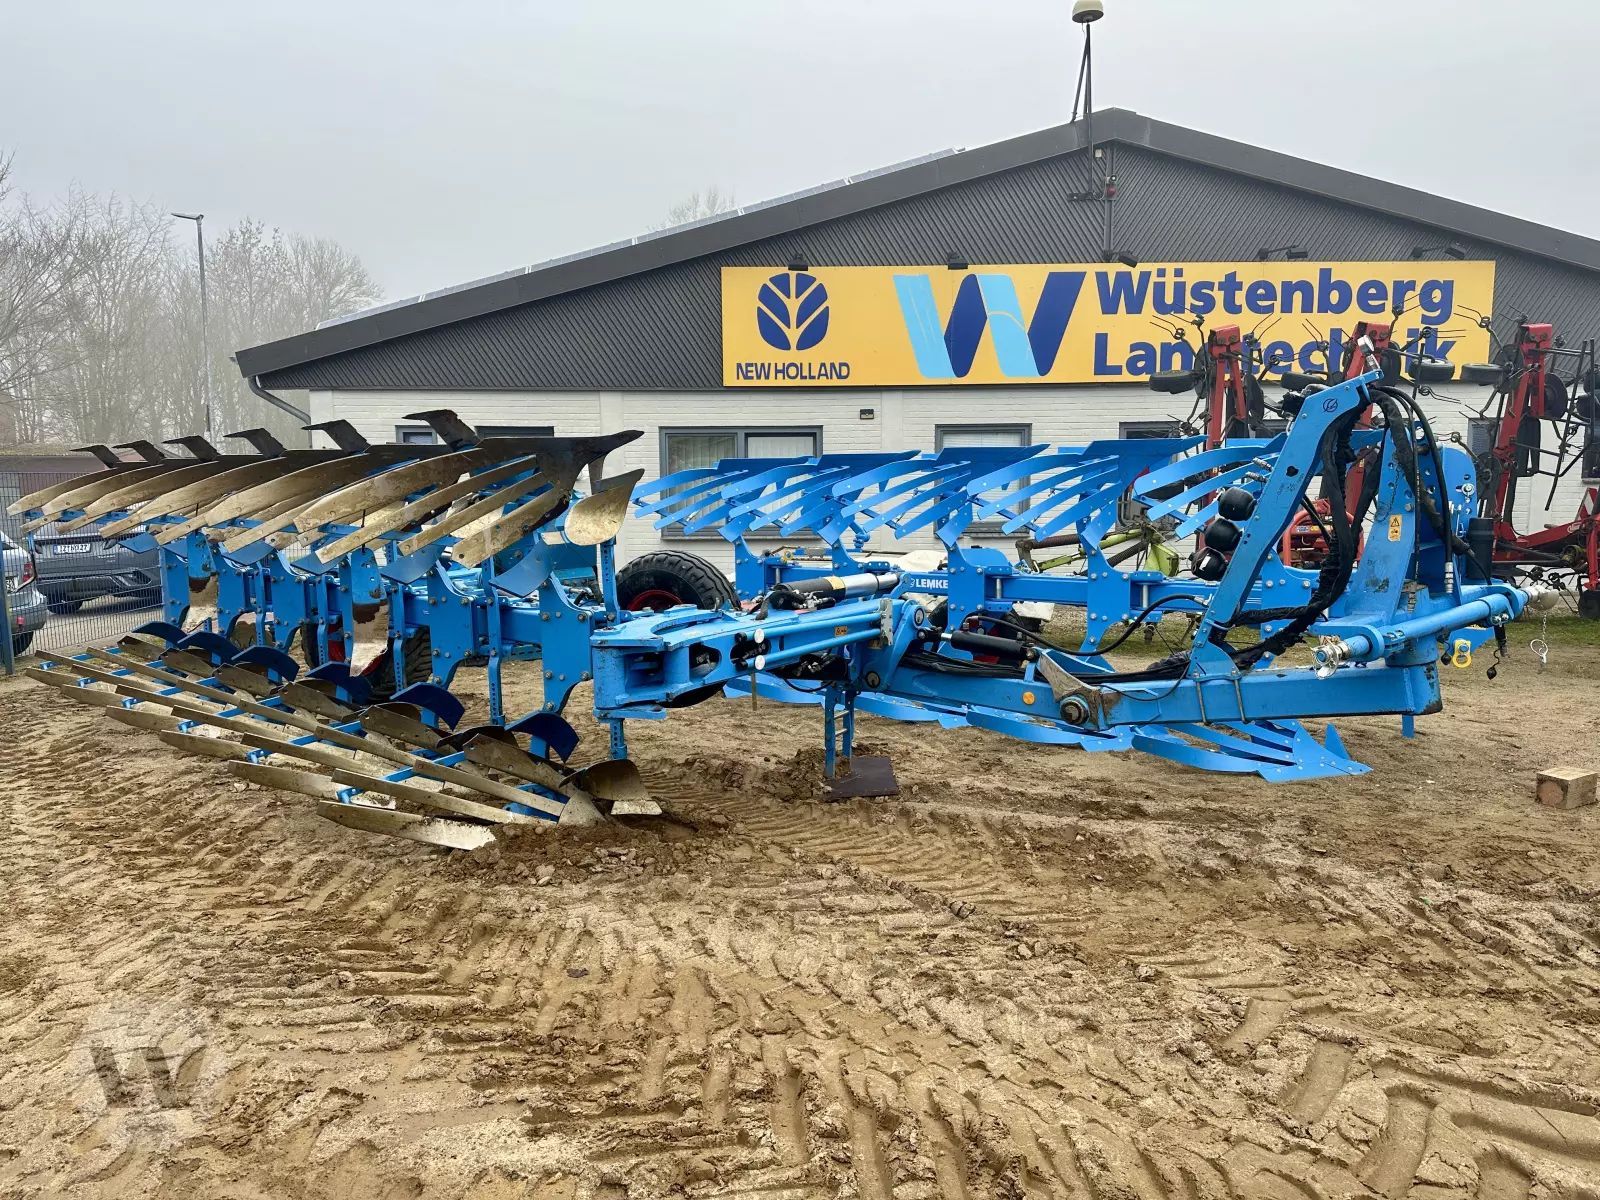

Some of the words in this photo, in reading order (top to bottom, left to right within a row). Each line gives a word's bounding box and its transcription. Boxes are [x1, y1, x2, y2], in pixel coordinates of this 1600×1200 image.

[1095, 267, 1454, 325] Wüstenberg
[736, 362, 771, 381] NEW
[774, 361, 850, 381] HOLLAND
